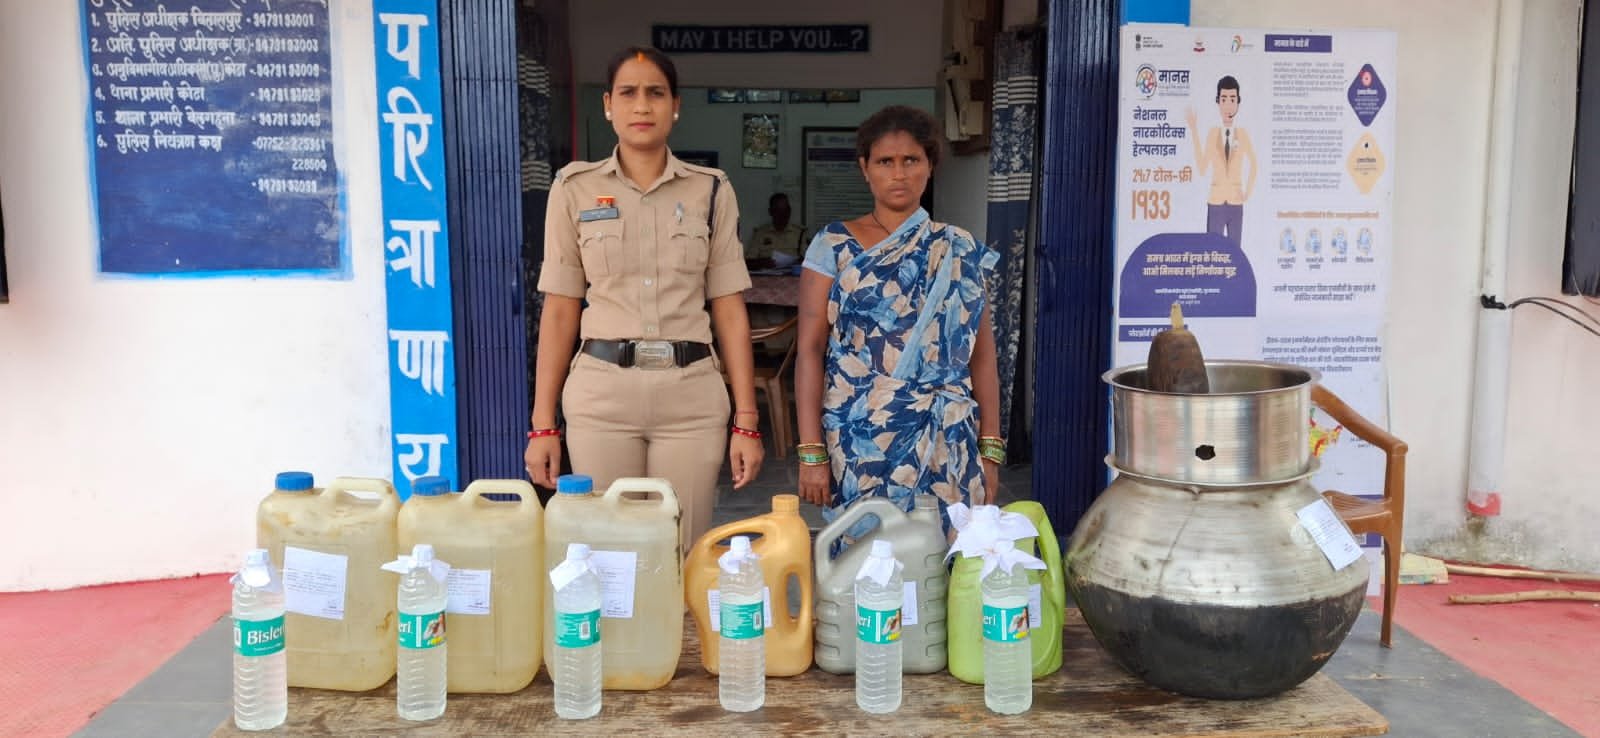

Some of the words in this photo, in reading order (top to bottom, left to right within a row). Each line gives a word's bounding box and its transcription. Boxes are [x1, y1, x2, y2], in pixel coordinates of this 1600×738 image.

[105, 7, 140, 32] पुलिस
[138, 31, 176, 58] पुलिस
[660, 30, 704, 49] MAY
[711, 31, 722, 49] I
[727, 30, 784, 49] HELP
[1158, 70, 1191, 84] मानस
[176, 80, 206, 101] कोटा
[1133, 106, 1168, 121] नेशनल
[1132, 123, 1186, 139] नारकोटिक्स
[114, 129, 150, 154] पुलिस
[1132, 141, 1177, 157] हेल्पलाइन
[1131, 190, 1171, 220] 1933
